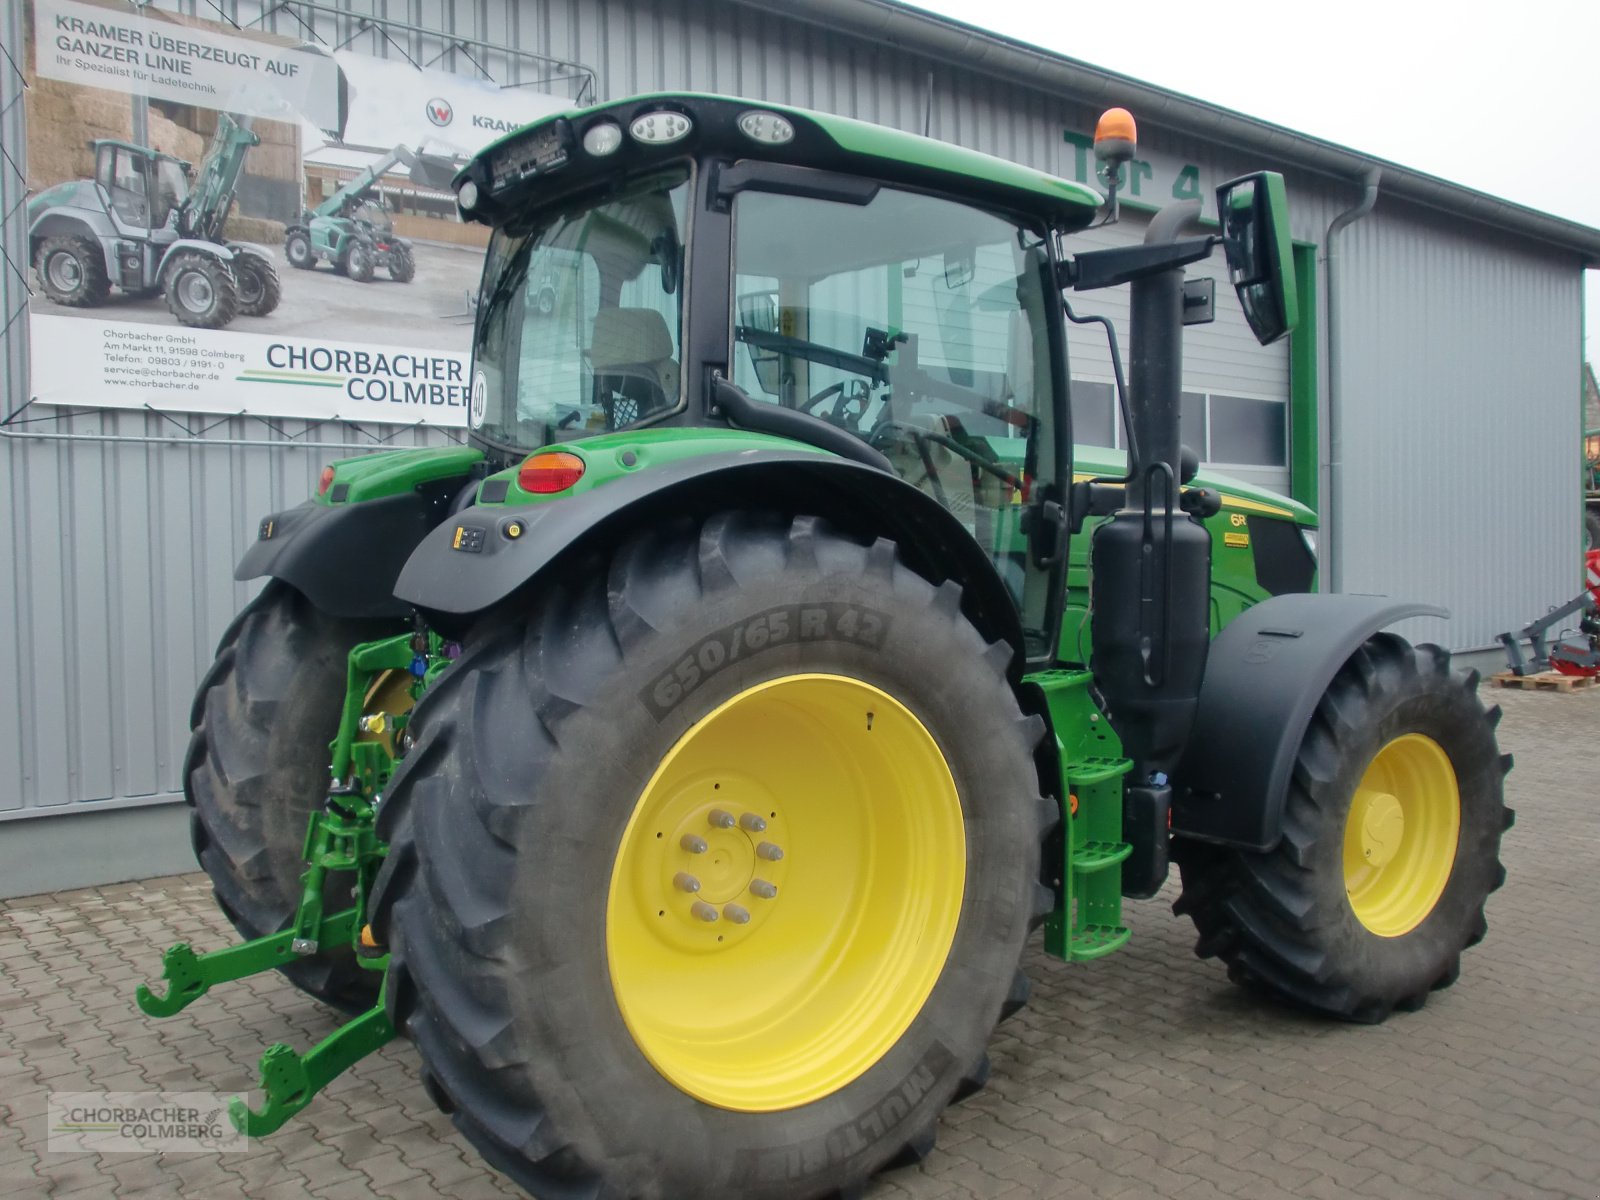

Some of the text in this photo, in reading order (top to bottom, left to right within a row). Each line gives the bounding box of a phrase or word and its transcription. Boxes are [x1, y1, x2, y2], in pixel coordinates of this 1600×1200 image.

[55, 13, 300, 78] KRAMER ÜBERZEUGT AUF
[56, 35, 192, 76] GANZER LINIE
[55, 54, 217, 95] Ihr Spezialist für Ladetechnik
[472, 114, 523, 133] KRAM
[1063, 129, 1203, 204] Tor 4
[103, 329, 196, 345] Chorbacher GmbH
[103, 342, 121, 351] Am
[122, 342, 153, 353] Markt
[168, 347, 198, 357] 91598
[200, 349, 246, 363] Colmberg
[104, 352, 143, 364] Telefon:
[147, 356, 181, 366] 09803
[266, 343, 463, 382] CHORBACHER
[104, 366, 219, 380] service@chorbacher.de
[104, 379, 199, 390] www.chorbacher.de
[473, 382, 484, 417] 40
[1231, 513, 1247, 527] 6R
[652, 609, 883, 707] 650/65 R 42
